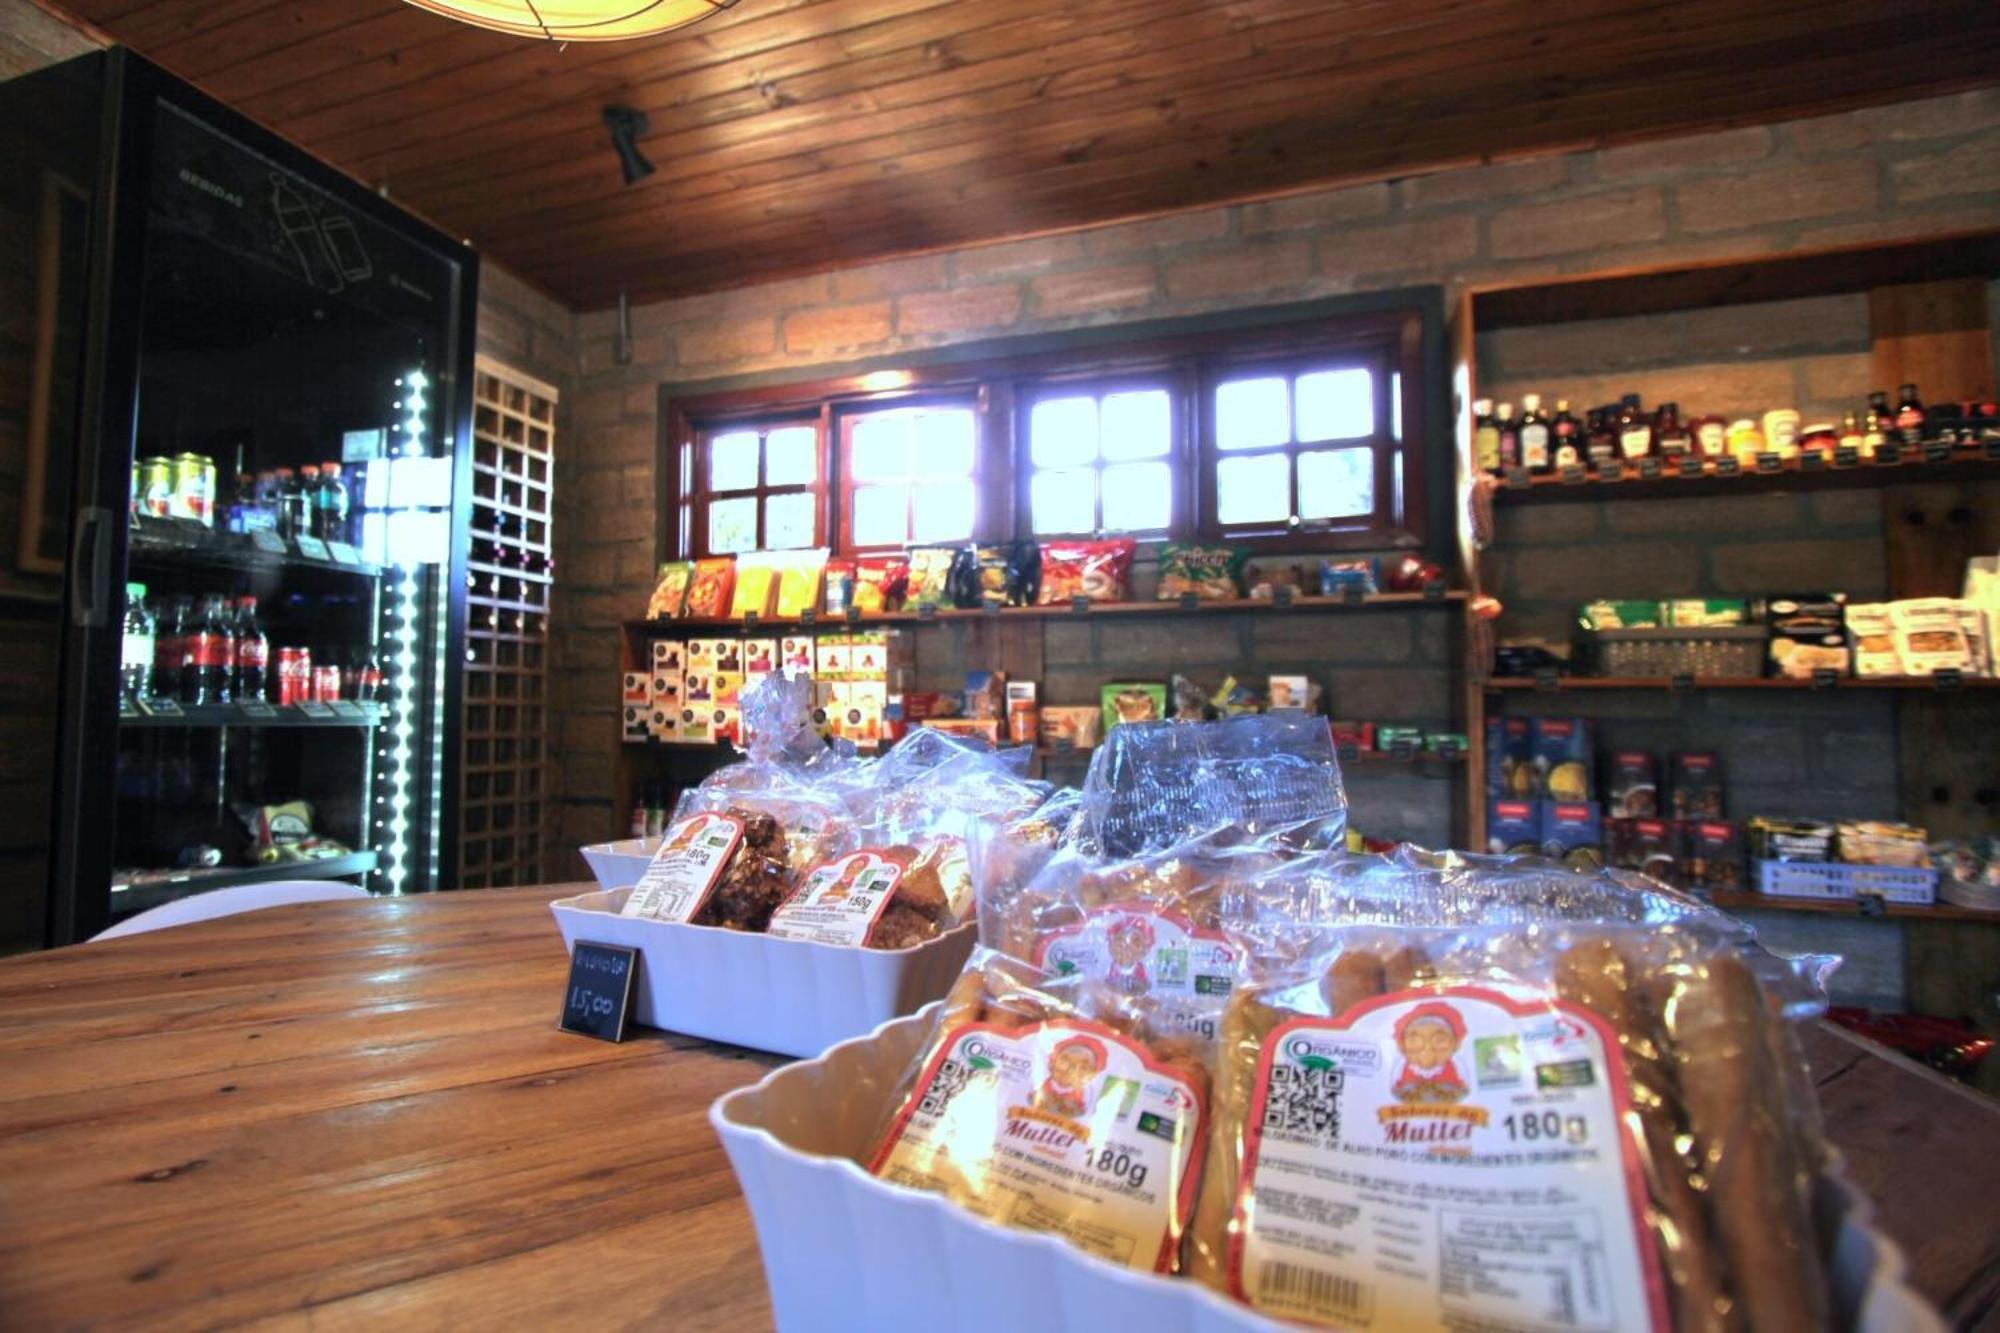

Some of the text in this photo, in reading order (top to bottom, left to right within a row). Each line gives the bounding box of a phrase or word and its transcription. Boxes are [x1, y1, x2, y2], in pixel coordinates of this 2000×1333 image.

[570, 986, 613, 1017] 15,00
[1503, 1109, 1588, 1144] 180g
[1085, 1148, 1148, 1189] 180g
